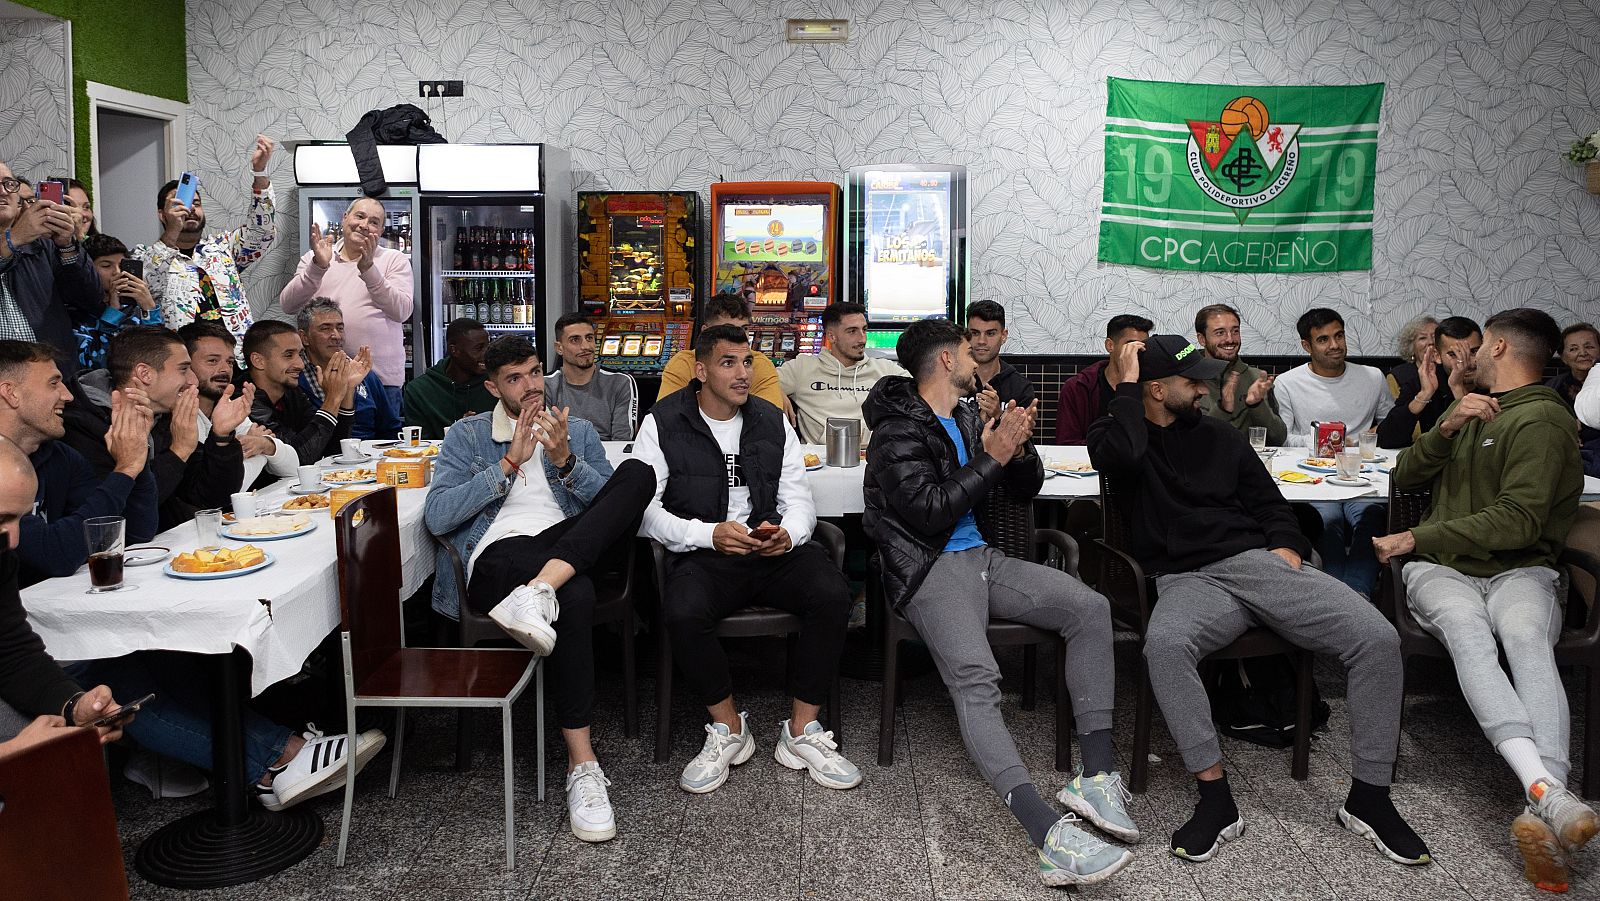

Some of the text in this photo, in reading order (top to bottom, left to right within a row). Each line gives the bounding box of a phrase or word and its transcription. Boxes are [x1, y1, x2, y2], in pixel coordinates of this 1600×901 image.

[1119, 144, 1173, 204] 19
[1190, 151, 1296, 206] CLUB POLIDEPORTIVO CACEREÑO
[1311, 149, 1366, 207] 19
[751, 315, 790, 325] Vikingos
